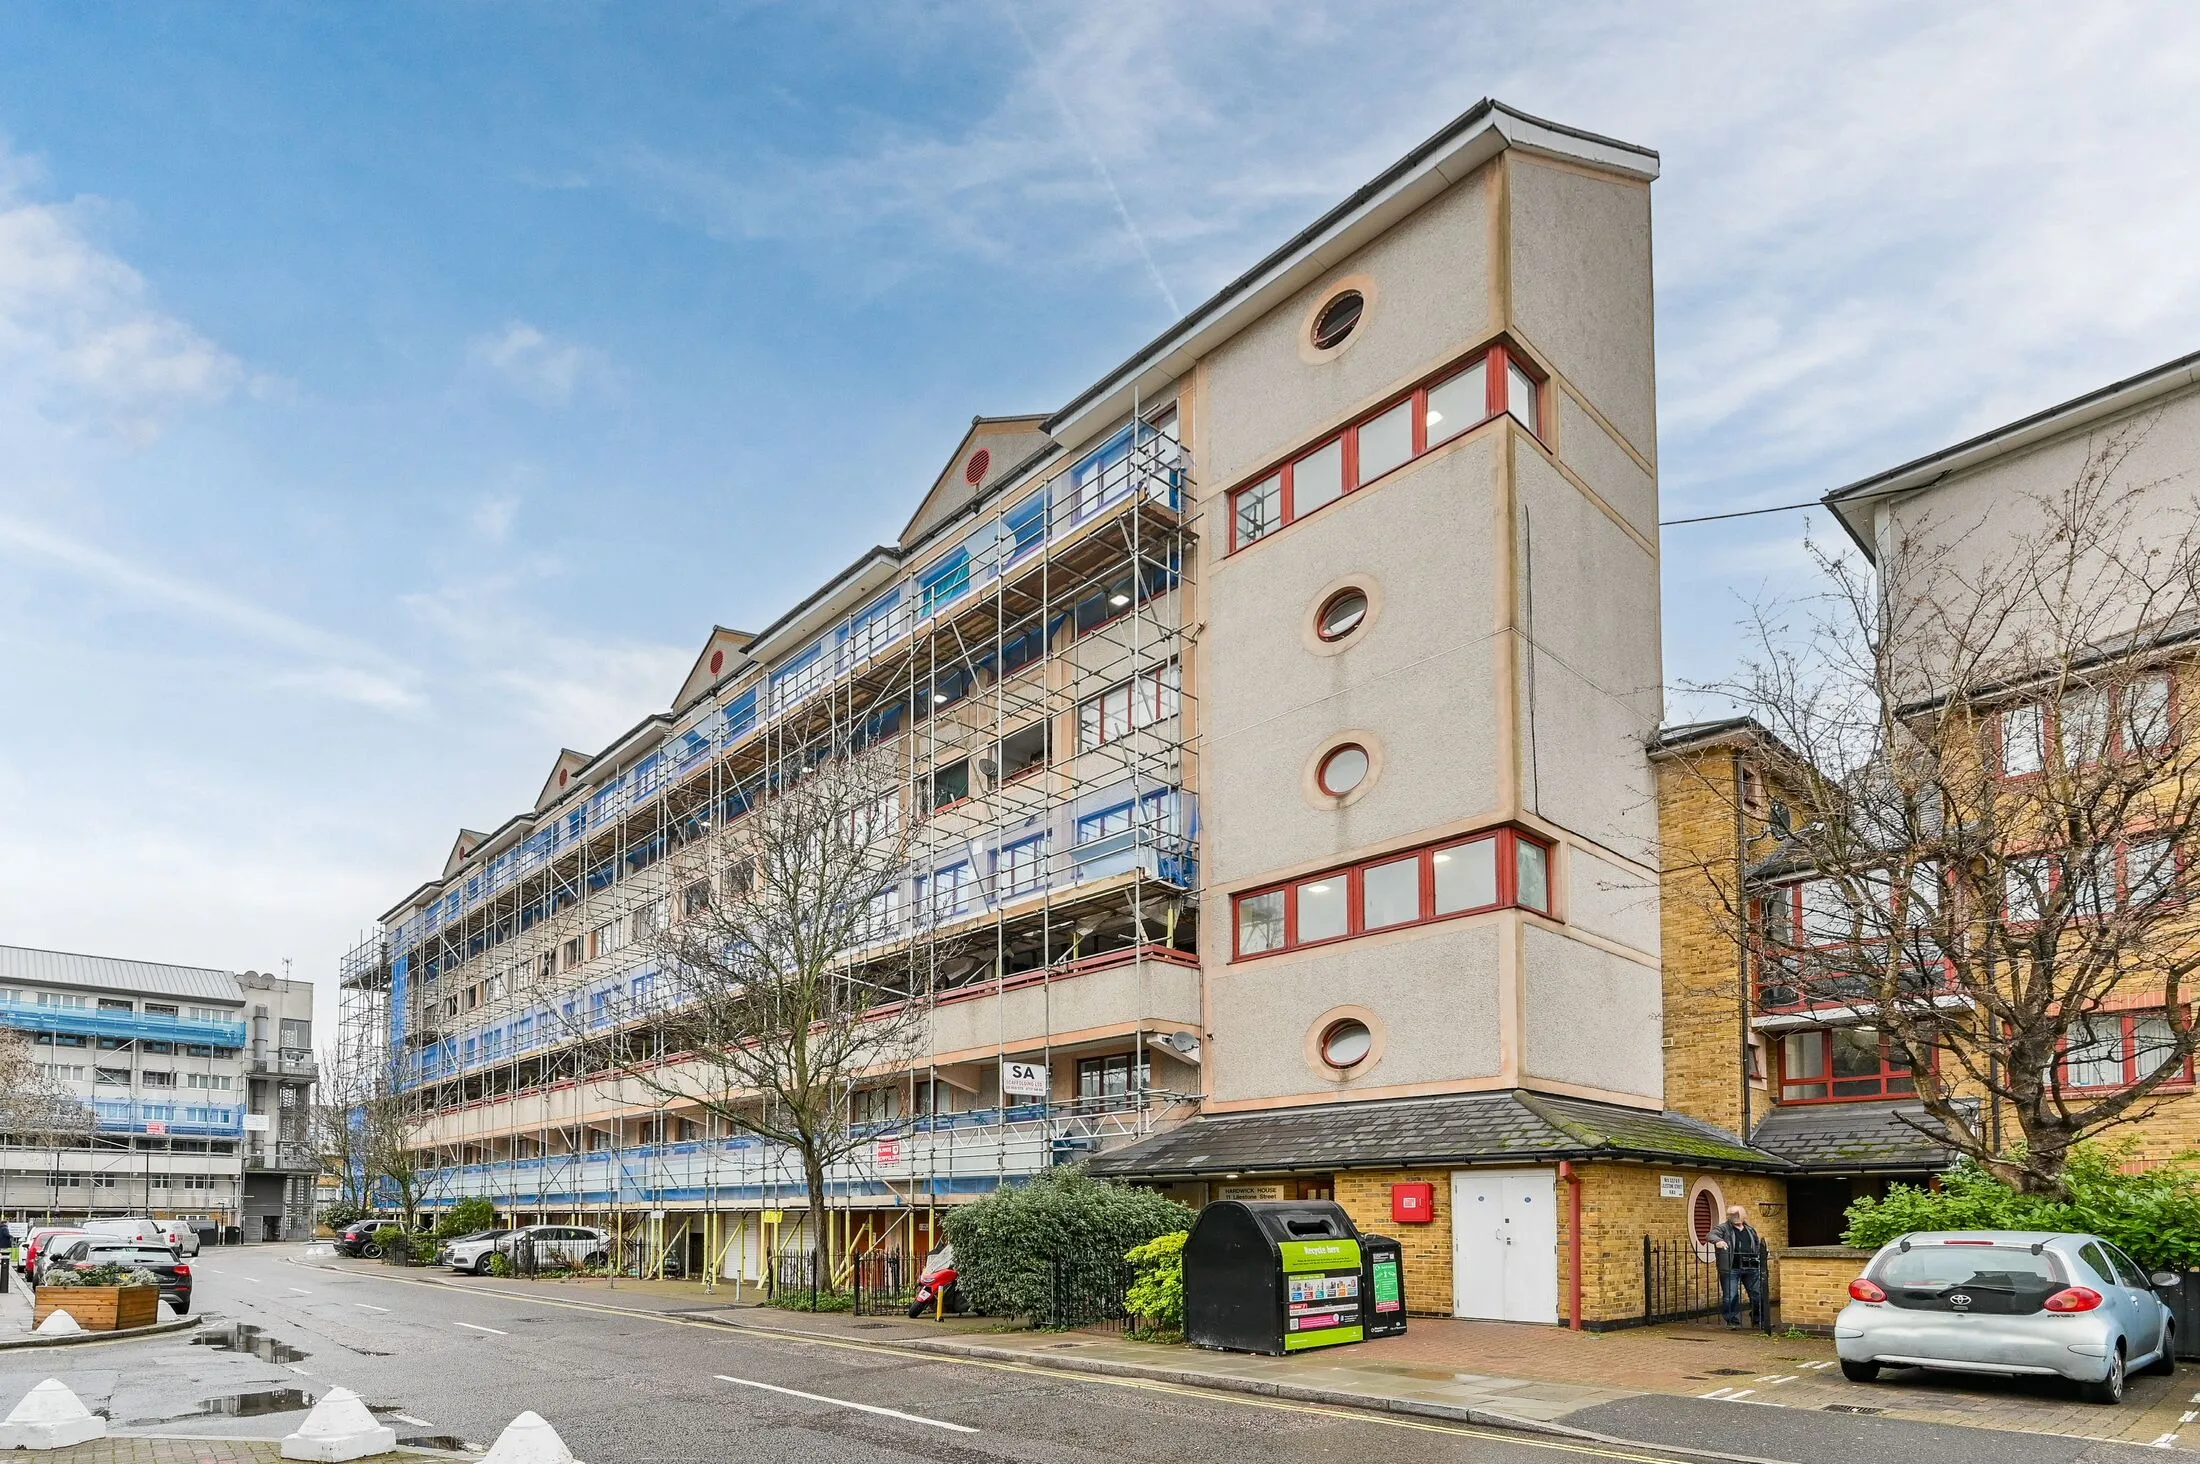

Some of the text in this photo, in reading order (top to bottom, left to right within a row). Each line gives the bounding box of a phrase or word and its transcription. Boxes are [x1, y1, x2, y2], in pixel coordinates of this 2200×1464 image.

[1012, 1065, 1035, 1080] SA
[1006, 1079, 1034, 1087] SCAFFOLDING
[1304, 1246, 1340, 1255] Recycle here
